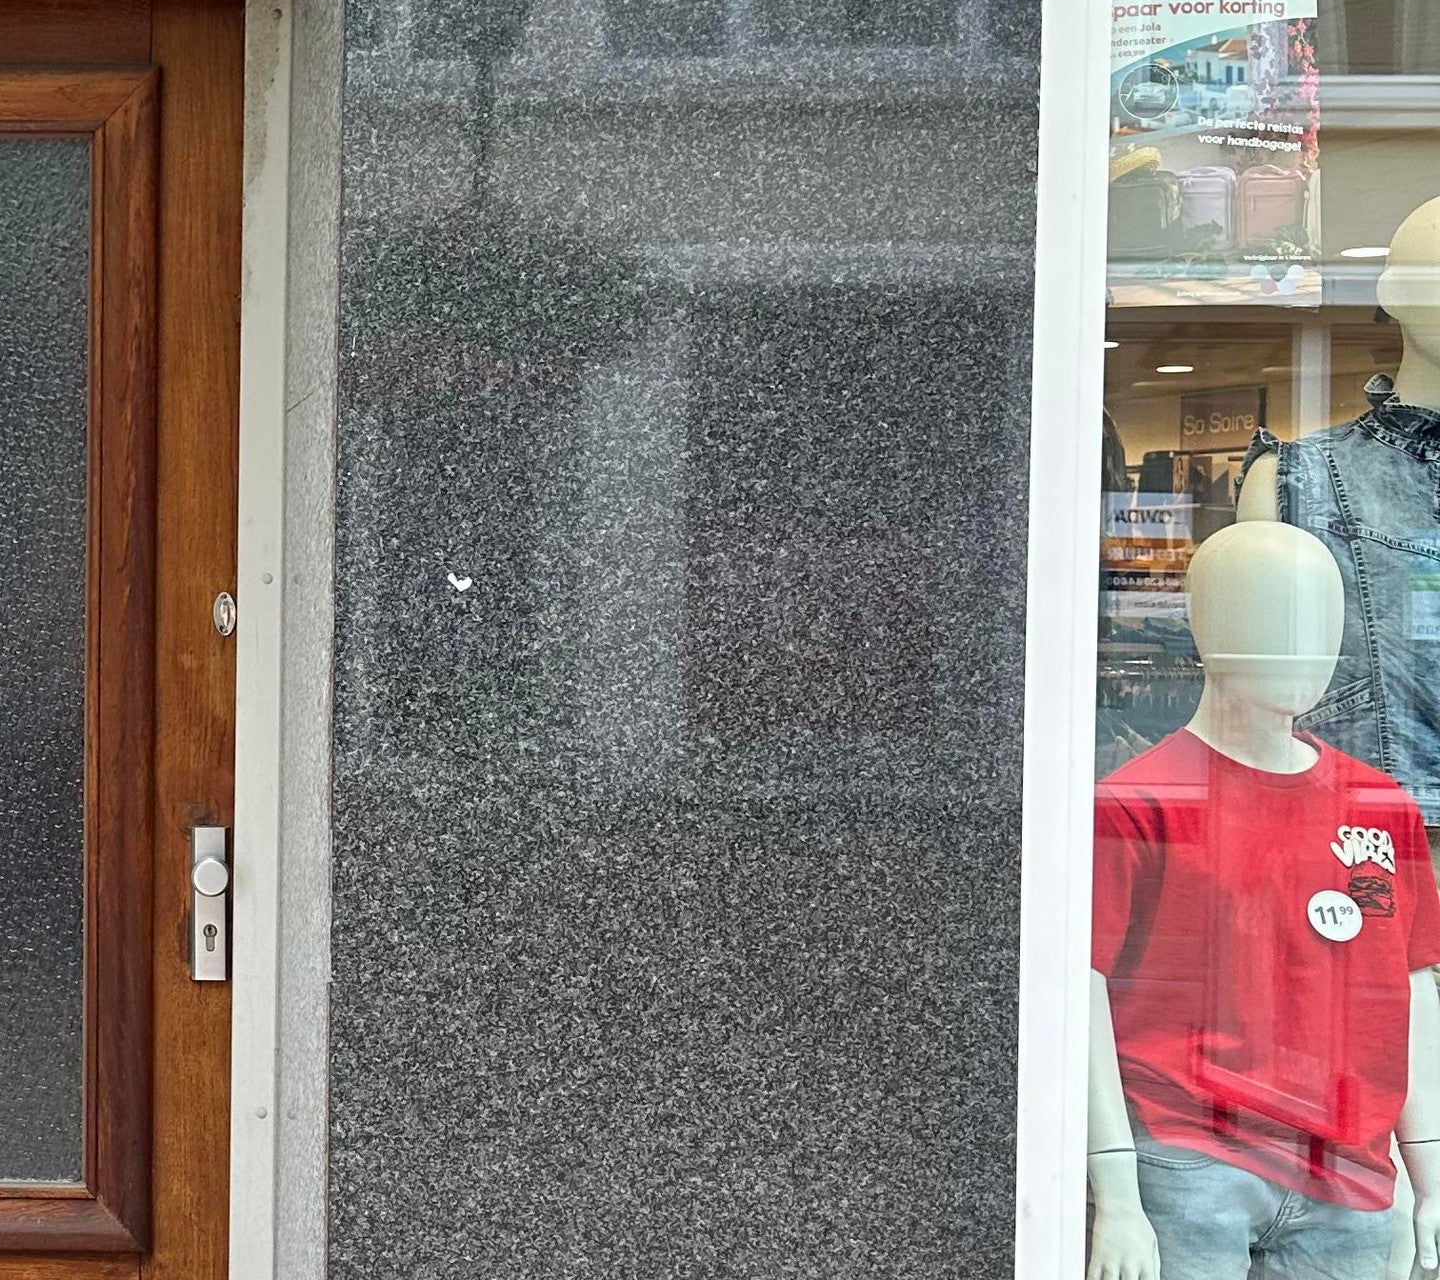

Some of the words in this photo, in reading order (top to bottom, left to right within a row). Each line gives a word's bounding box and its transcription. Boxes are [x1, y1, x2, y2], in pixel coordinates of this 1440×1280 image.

[1111, 4, 1162, 22] paar
[1168, 1, 1215, 15] voor
[1111, 37, 1167, 48] nderseater
[1198, 116, 1213, 127] De
[1214, 119, 1266, 131] perfecte
[1267, 122, 1304, 135] reistas
[1197, 134, 1225, 145] voor
[1337, 825, 1394, 848] GOOD
[1314, 906, 1354, 927] 11,99
